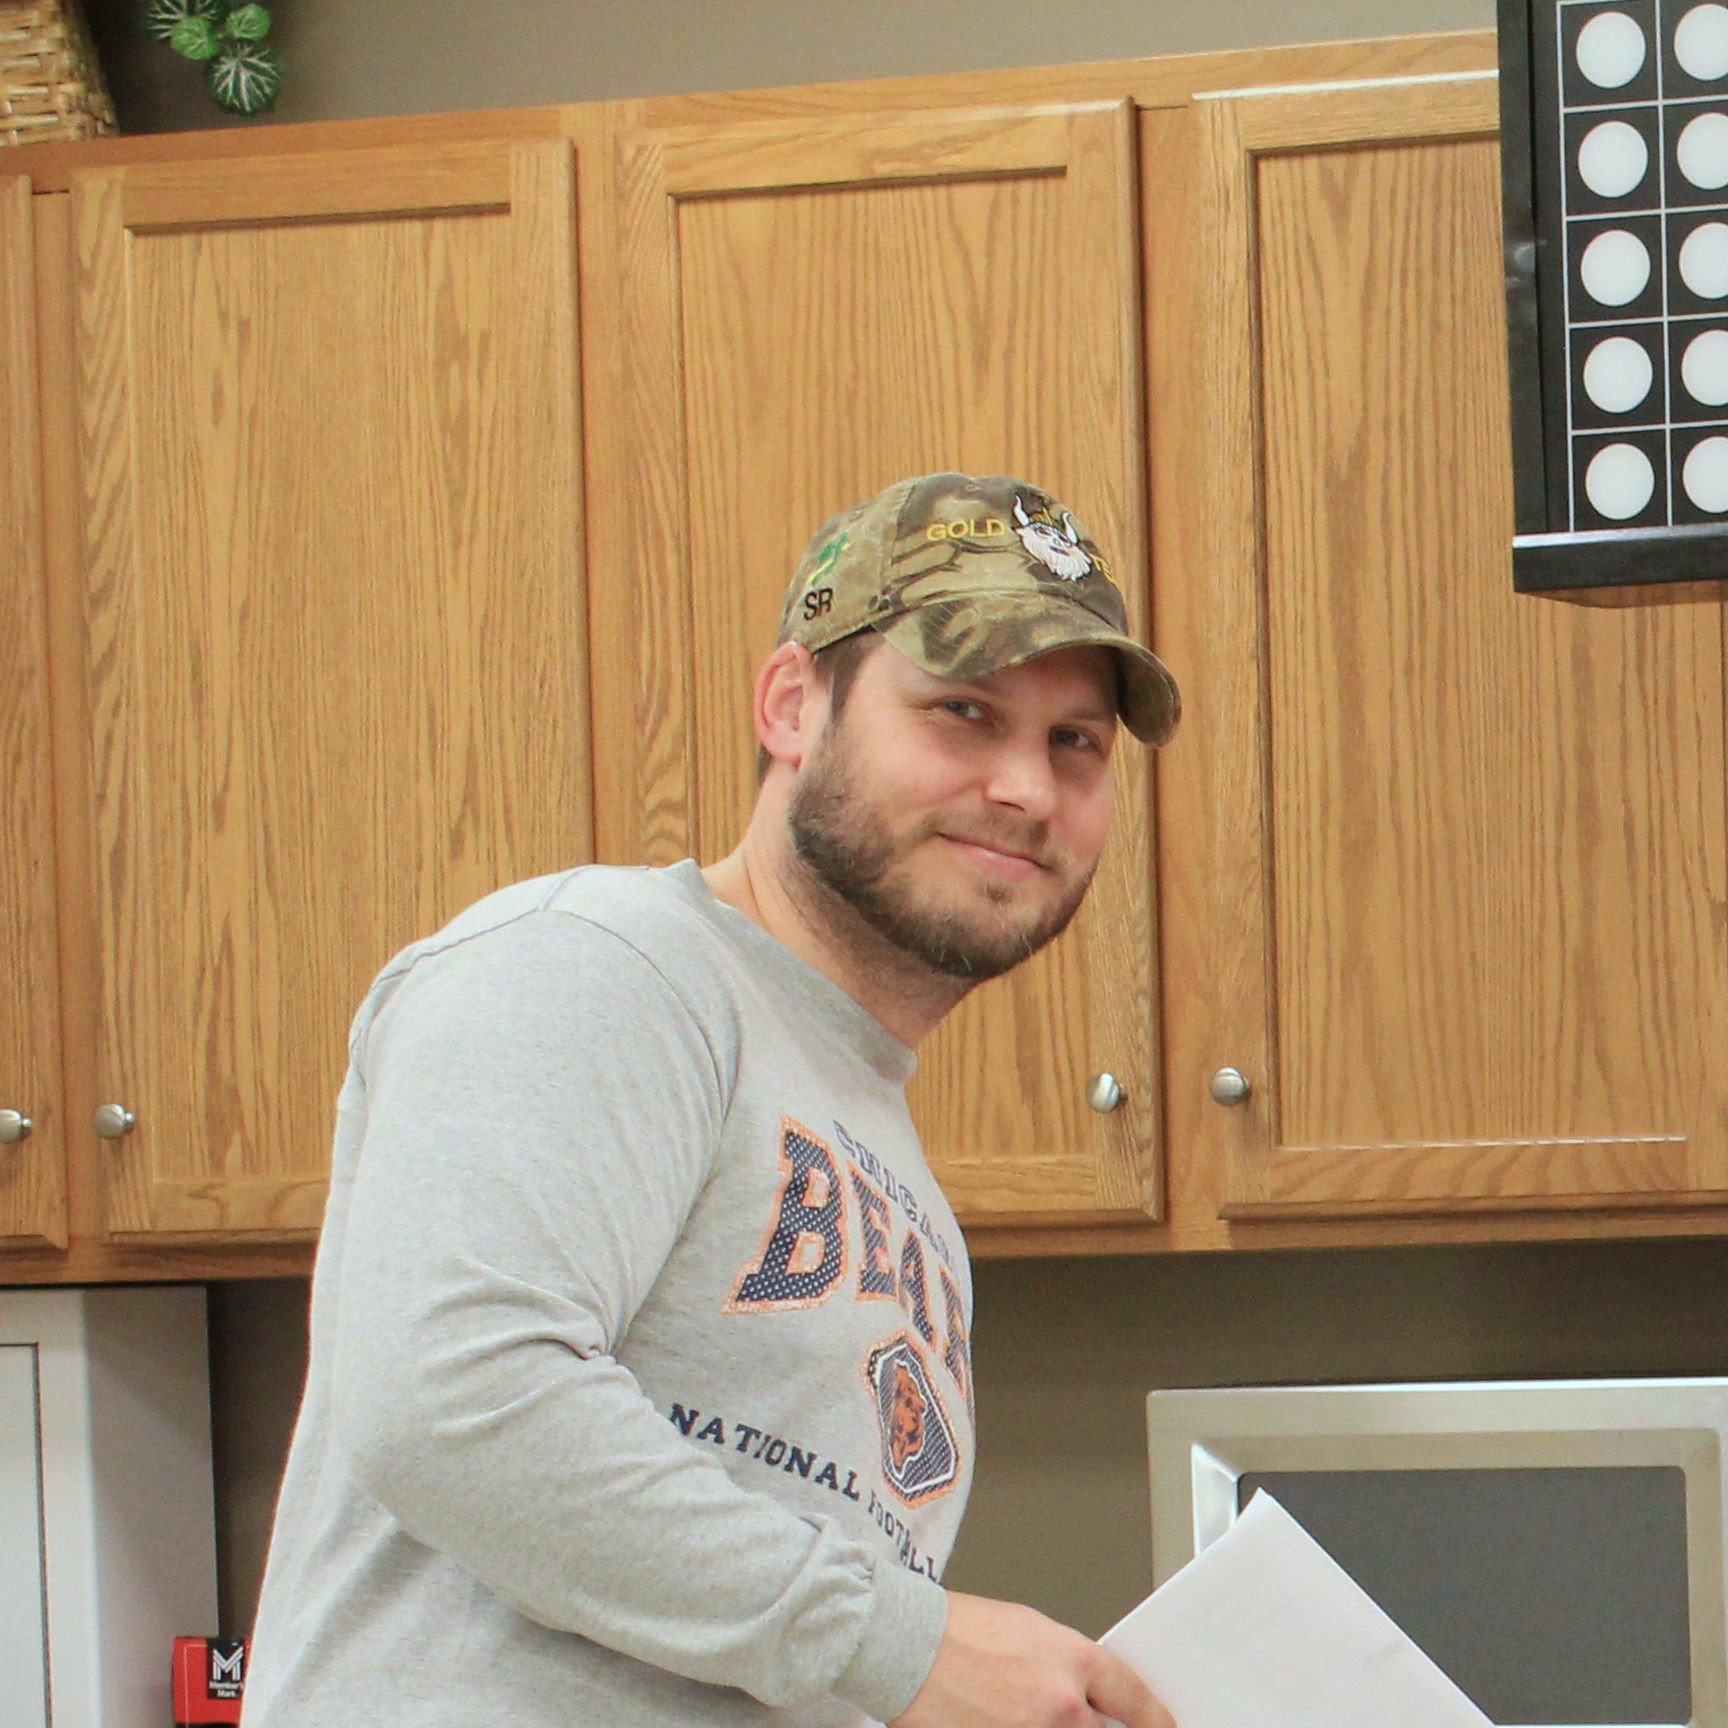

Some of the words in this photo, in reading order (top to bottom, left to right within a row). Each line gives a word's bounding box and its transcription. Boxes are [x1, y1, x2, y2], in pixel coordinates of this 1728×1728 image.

[926, 518, 1006, 541] GOLD
[803, 587, 835, 621] SR
[720, 1114, 972, 1404] BEAR
[669, 1402, 861, 1501] NATIONAL
